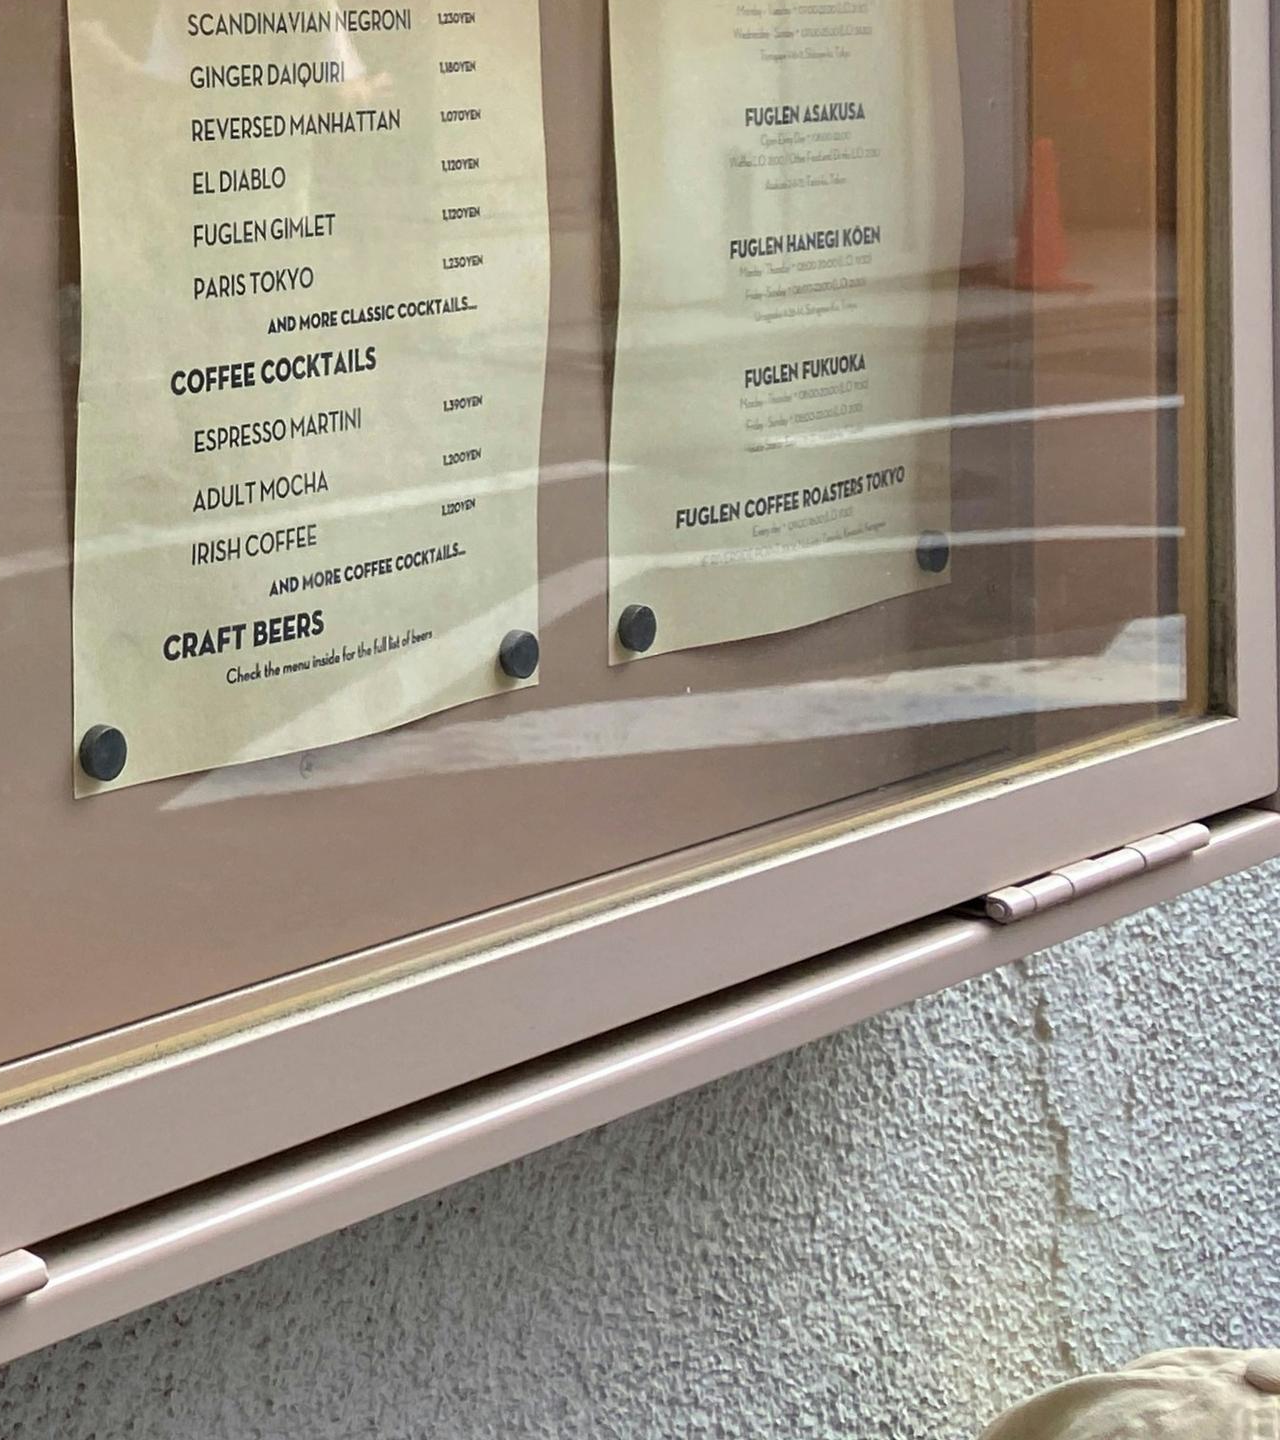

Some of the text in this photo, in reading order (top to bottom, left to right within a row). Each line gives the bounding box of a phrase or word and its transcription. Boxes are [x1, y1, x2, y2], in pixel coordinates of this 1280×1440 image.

[187, 12, 331, 37] SCANDINAVIAN
[335, 9, 411, 33] NEGRONI
[190, 65, 263, 89] GINGER
[267, 61, 345, 87] DAIQUIRI
[192, 117, 285, 142] REVERSED
[290, 109, 401, 136] MANHATTAN
[745, 102, 865, 126] FUGLEN ASAKUSA
[193, 172, 215, 194] EL
[220, 167, 286, 192] DIABLO
[194, 219, 267, 248] FUGLEN
[270, 213, 336, 240] GIMLET
[730, 235, 783, 259] FUGLEN
[787, 230, 839, 253] HANEGI
[194, 273, 246, 300] PARIS
[250, 267, 314, 294] TOKYO
[268, 317, 296, 335] AND
[299, 312, 338, 330] MORE
[341, 304, 395, 326] CLASSIC
[171, 346, 377, 396] COFFEE COCKTAILS
[745, 354, 866, 388] FUGLEN FUKUOKA
[194, 419, 286, 453] ESPRESSO
[290, 407, 362, 438] MARTINI
[192, 481, 255, 512] ADULT
[260, 470, 329, 503] MOCHA
[676, 502, 740, 529] FUGLEN
[745, 491, 799, 518] COFFEE
[803, 478, 864, 508] ROASTERS
[866, 466, 905, 491] TOKYO
[192, 537, 240, 566] IRISH
[245, 524, 317, 559] COFFEE
[269, 578, 299, 597] AND
[302, 570, 341, 591] MORE
[344, 558, 393, 582] COFFEE
[163, 610, 324, 661] CRAFT BEERS
[226, 629, 433, 684] Check the menu inside for the full list of beers
